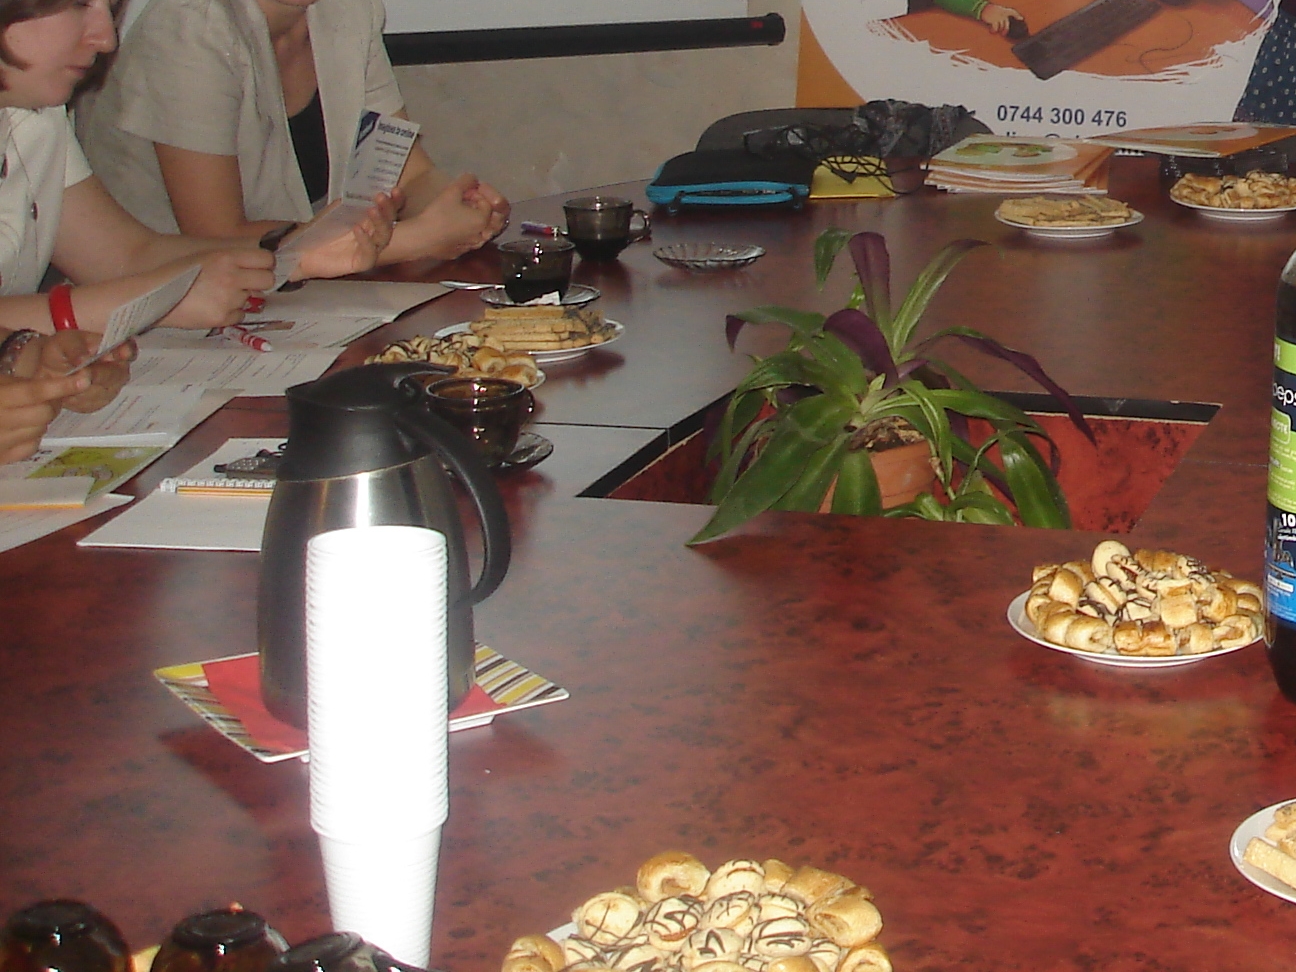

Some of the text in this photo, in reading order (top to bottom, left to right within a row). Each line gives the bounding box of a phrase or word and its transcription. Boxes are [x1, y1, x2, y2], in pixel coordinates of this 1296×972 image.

[996, 104, 1127, 128] 0744 300 476
[1281, 513, 1296, 528] 10
